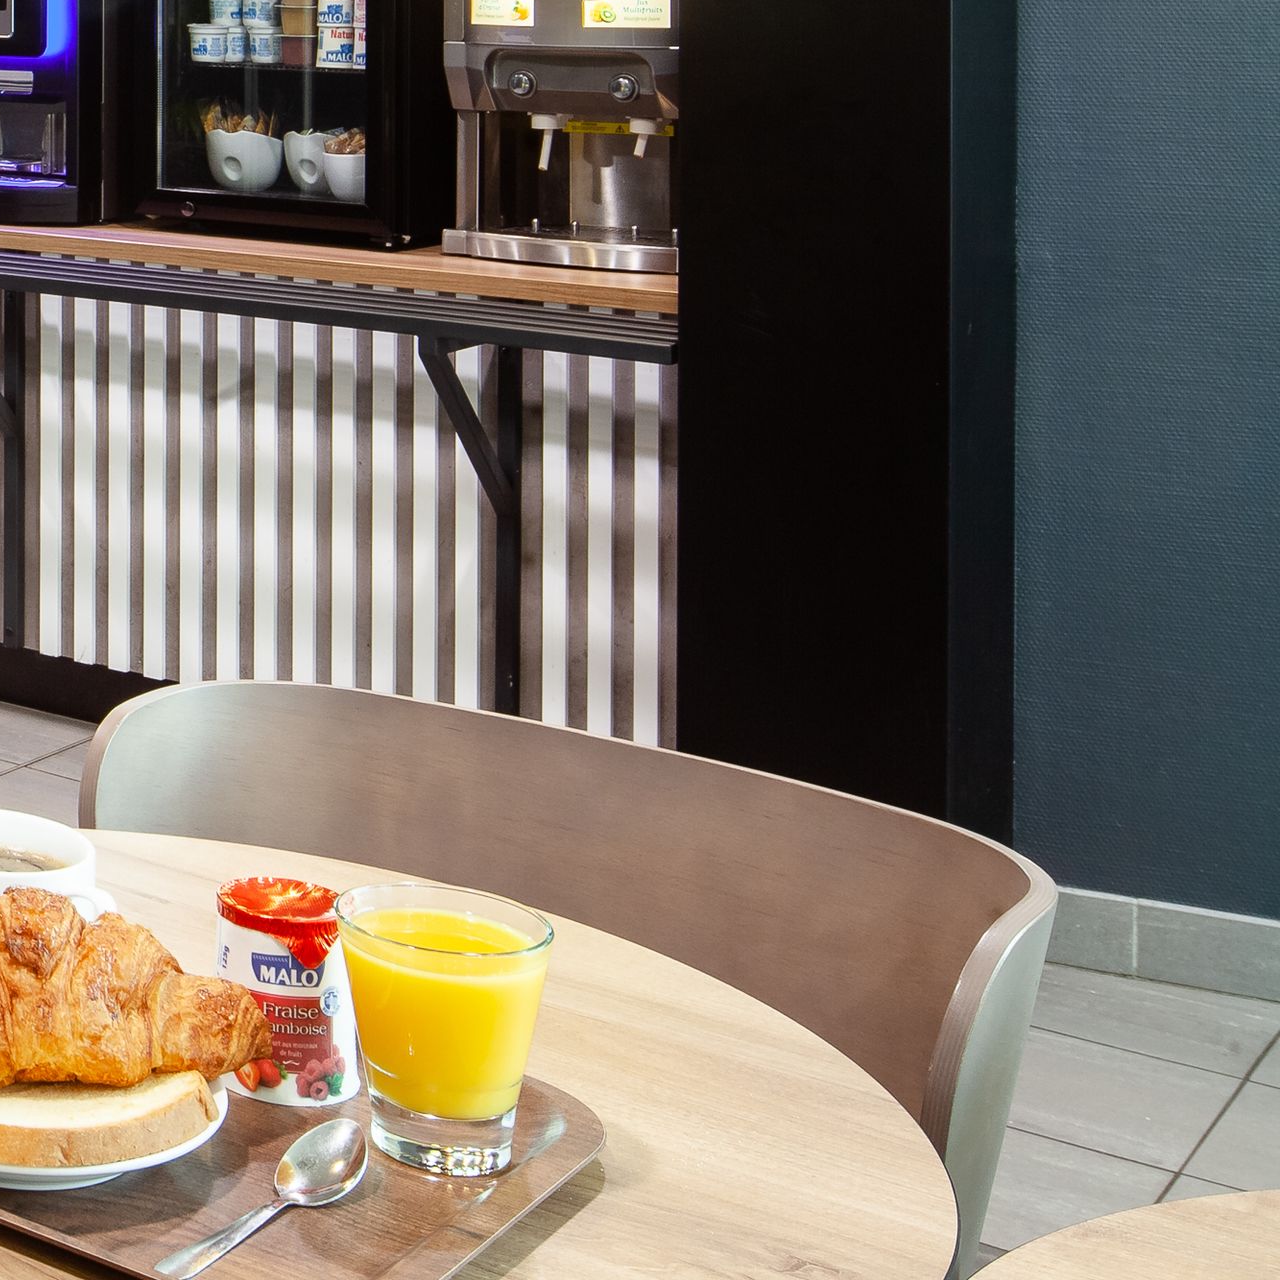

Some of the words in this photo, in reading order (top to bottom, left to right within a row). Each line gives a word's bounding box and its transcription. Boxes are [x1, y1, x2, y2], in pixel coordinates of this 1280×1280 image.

[331, 29, 353, 39] Natur
[260, 965, 319, 987] MALO
[263, 1001, 320, 1020] Fraise
[272, 1023, 328, 1036] amboise
